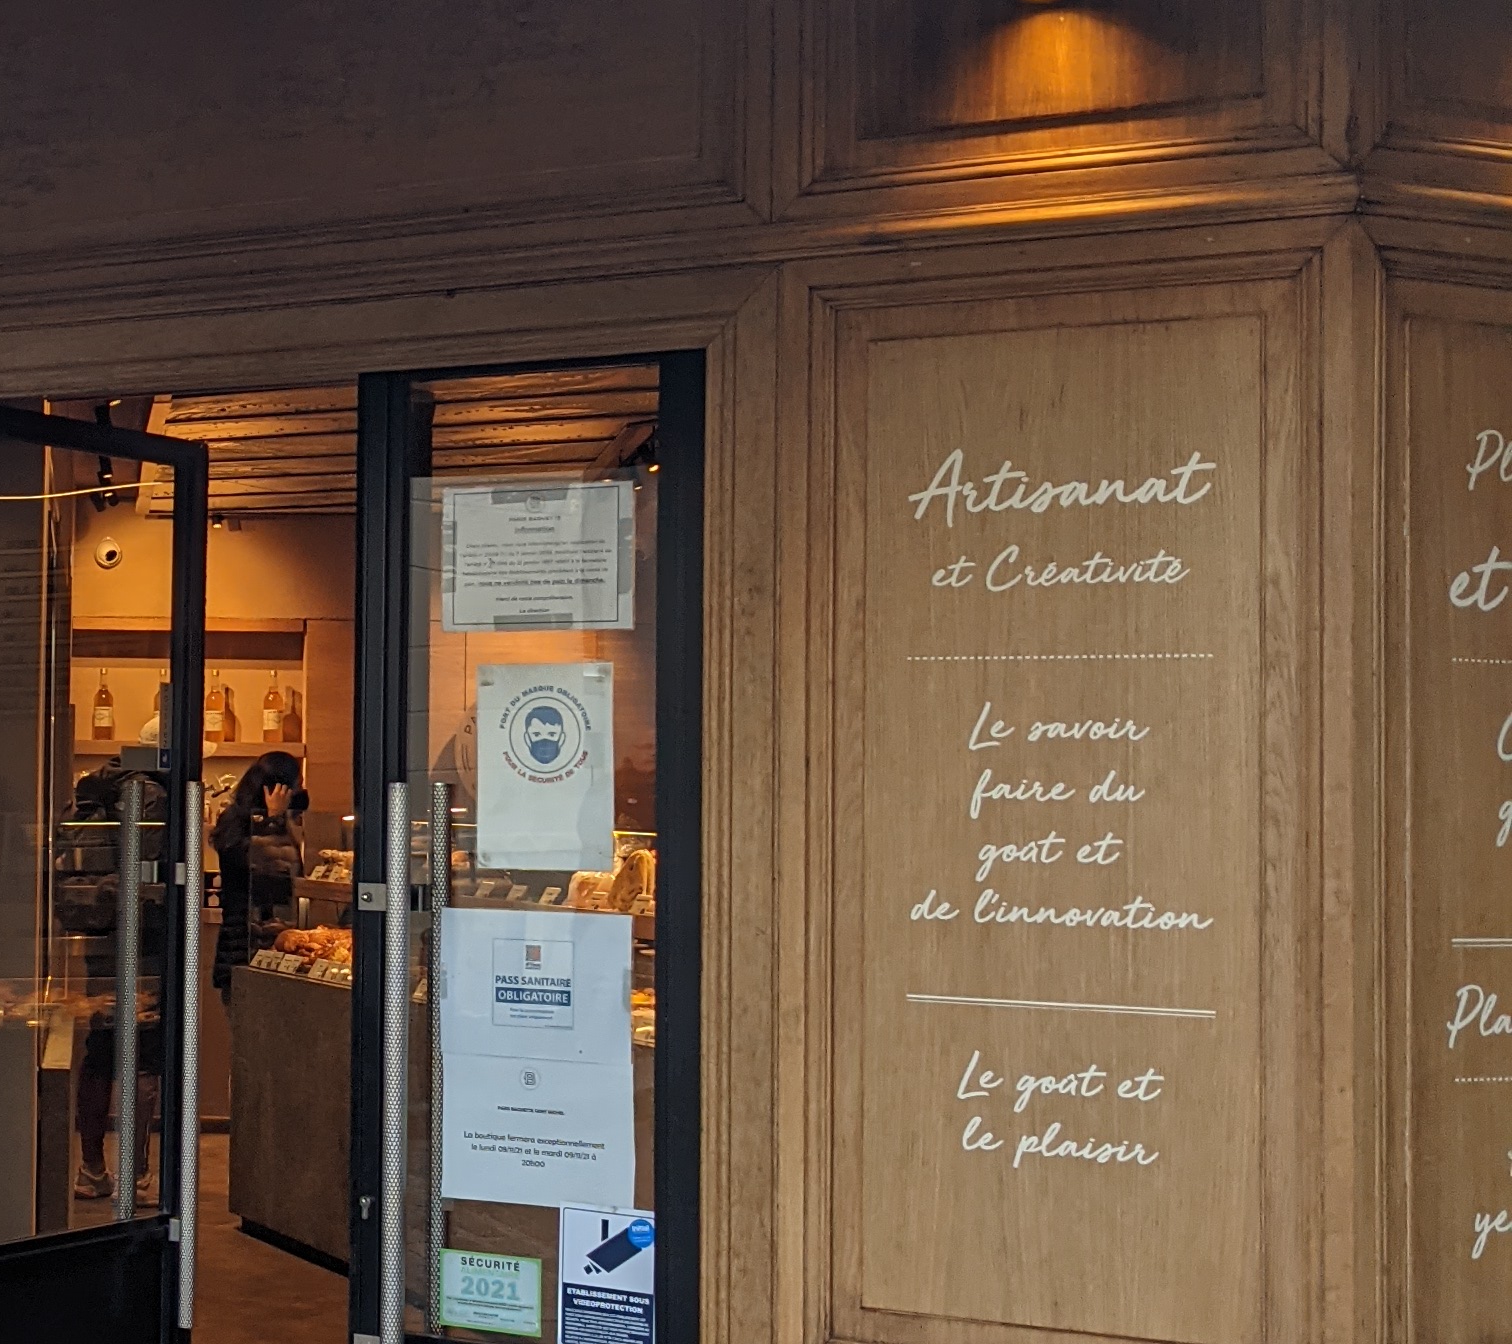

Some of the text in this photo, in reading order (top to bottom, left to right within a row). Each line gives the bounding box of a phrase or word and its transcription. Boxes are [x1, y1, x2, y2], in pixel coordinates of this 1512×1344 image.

[908, 448, 1217, 528] Artisanat
[931, 544, 1191, 592] et Créativité
[1449, 545, 1512, 611] et
[510, 696, 521, 707] DU
[521, 685, 555, 698] MASQUE
[968, 701, 1150, 751] Le savoir
[970, 768, 1146, 820] faire du
[1076, 832, 1124, 865] et
[910, 888, 1214, 930] de l'innovation
[495, 975, 572, 988] PASS SANITAIRE
[497, 990, 569, 1003] OBLIGATOIRE
[957, 1049, 1004, 1099] Le
[1117, 1068, 1165, 1101] et
[962, 1116, 1160, 1168] le plaisir
[460, 1256, 520, 1272] SÉCURITÉ
[460, 1276, 520, 1301] 2021
[629, 1295, 650, 1305] SOUS
